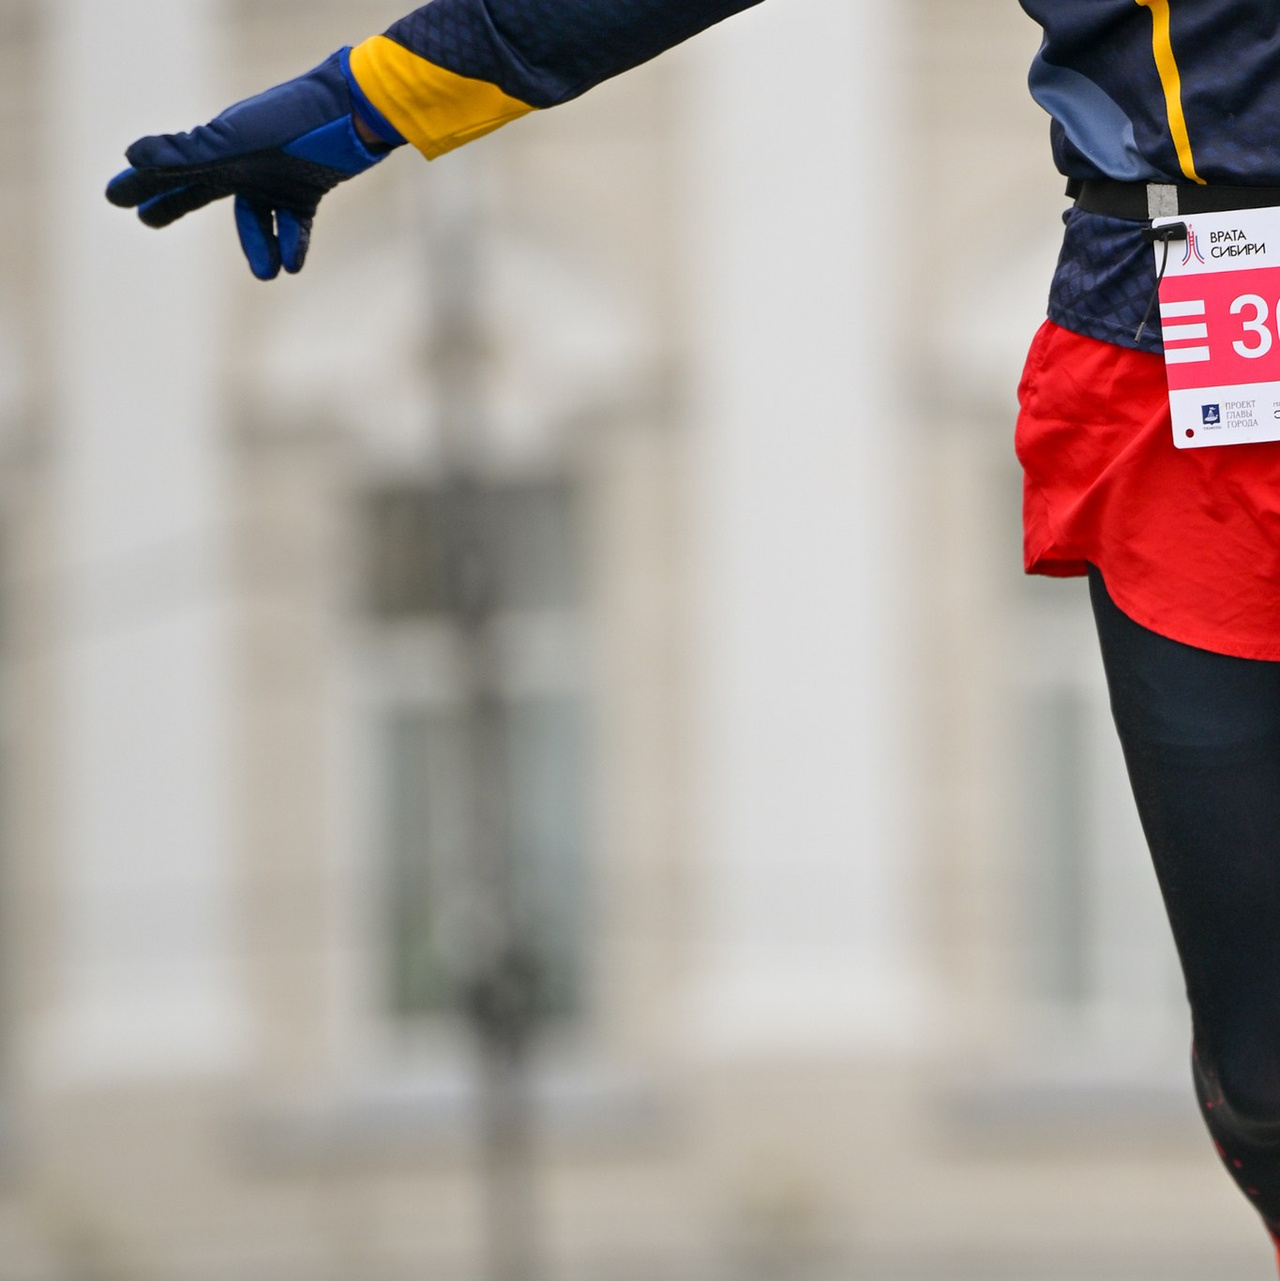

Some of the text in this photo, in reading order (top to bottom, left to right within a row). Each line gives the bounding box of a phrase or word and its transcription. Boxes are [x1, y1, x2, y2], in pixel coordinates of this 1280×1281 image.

[1210, 229, 1247, 243] ВРАТА
[1210, 242, 1266, 258] СИБИРИ
[1225, 400, 1256, 410] ПРОЕКТ
[1226, 410, 1253, 419] ГЛАВЫ
[1227, 419, 1259, 429] ГОРОДА
